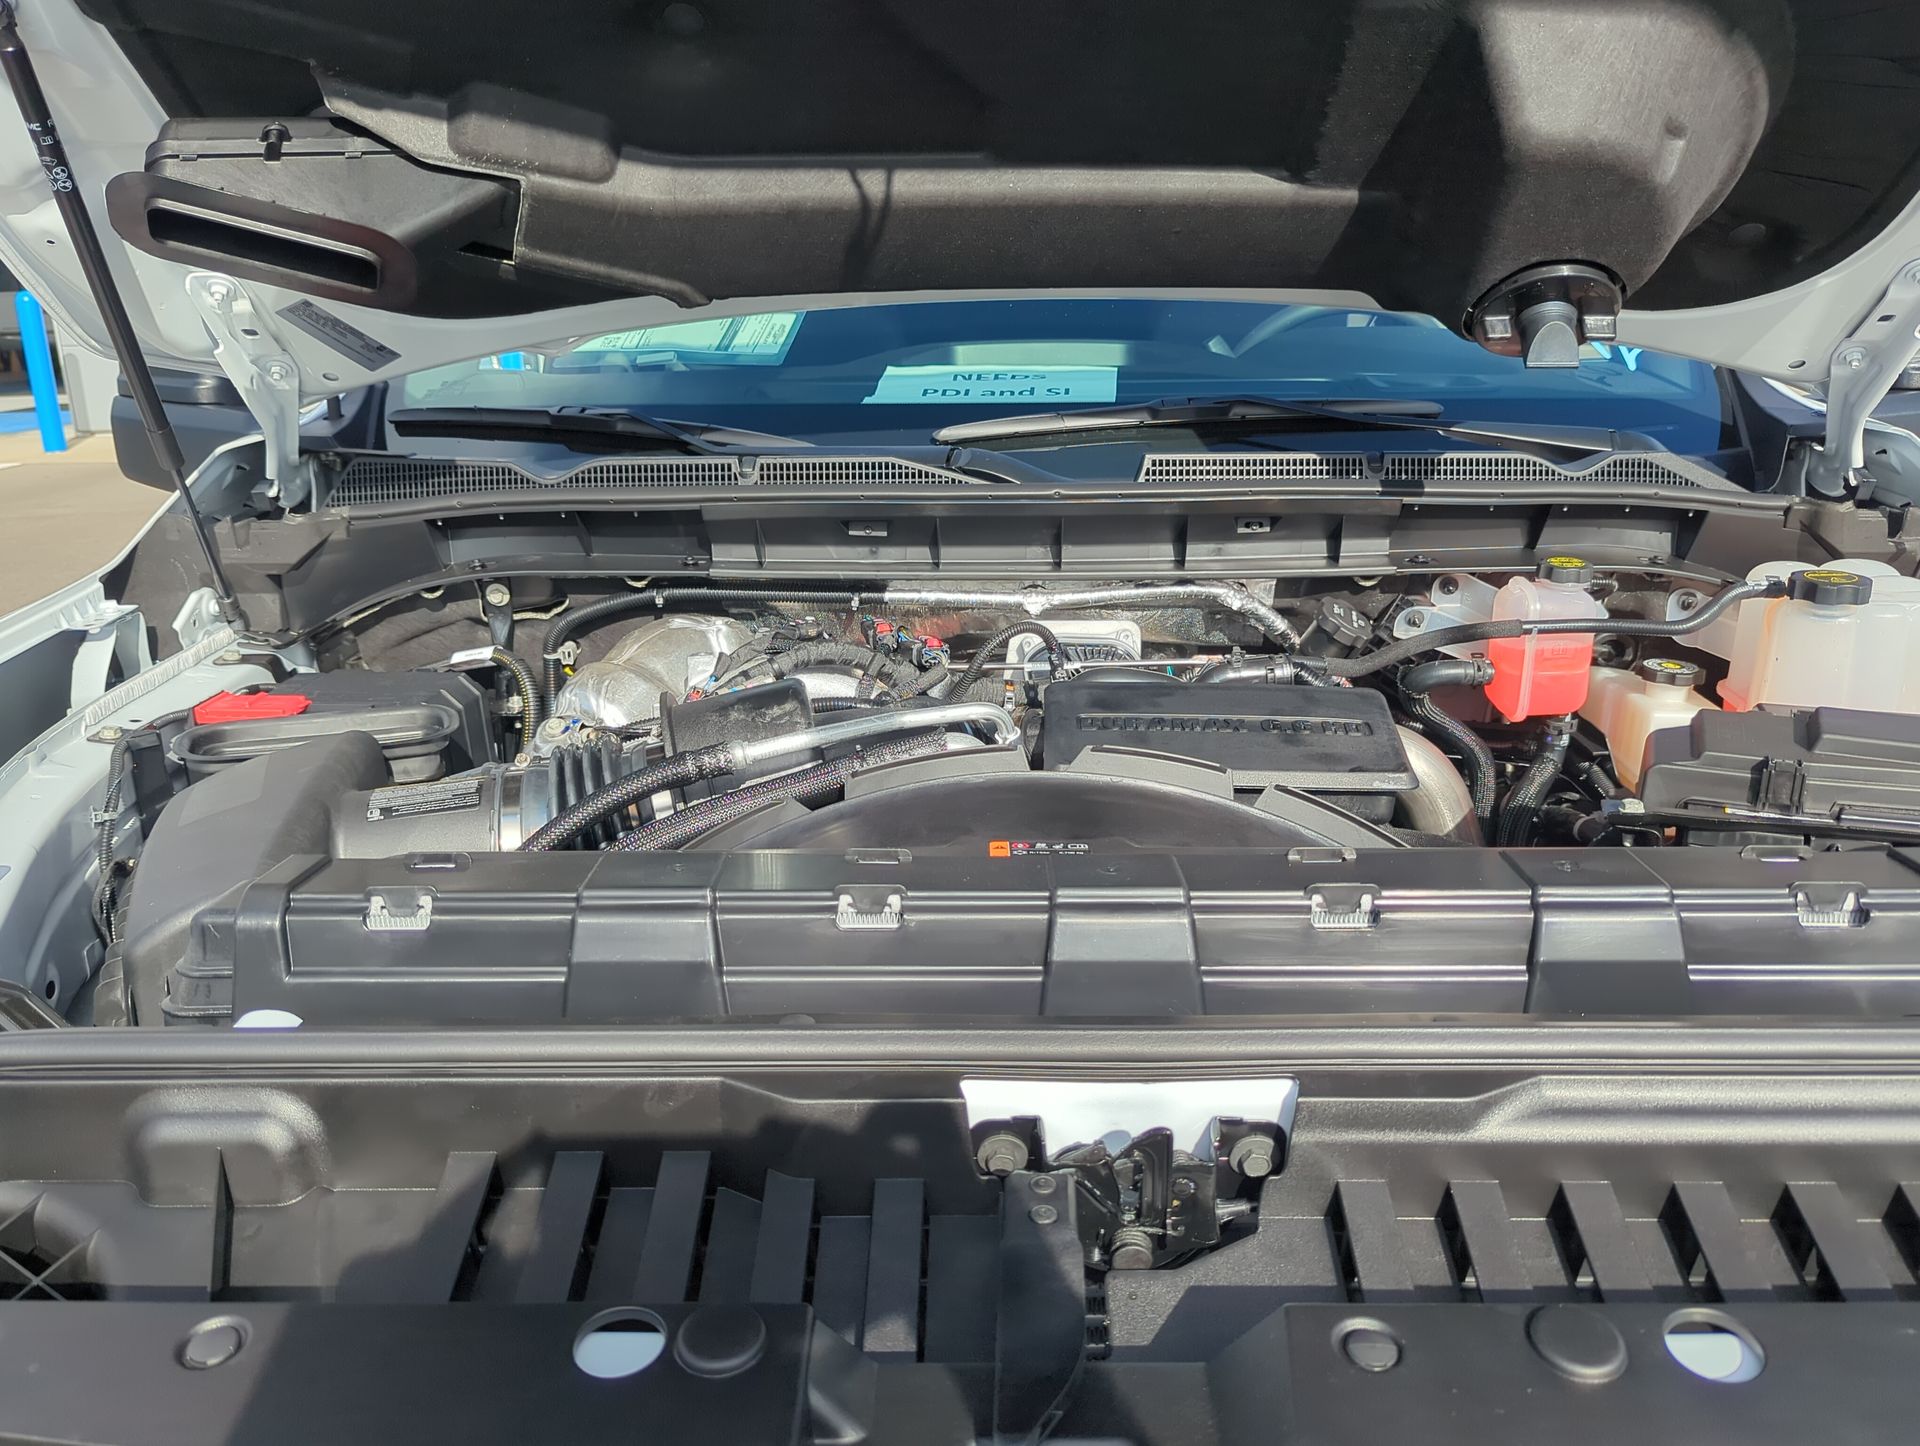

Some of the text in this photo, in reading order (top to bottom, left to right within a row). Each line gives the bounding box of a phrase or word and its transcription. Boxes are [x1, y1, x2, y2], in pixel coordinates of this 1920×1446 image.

[921, 387, 1071, 397] PDI and SI
[1077, 716, 1248, 732] DURAMAX
